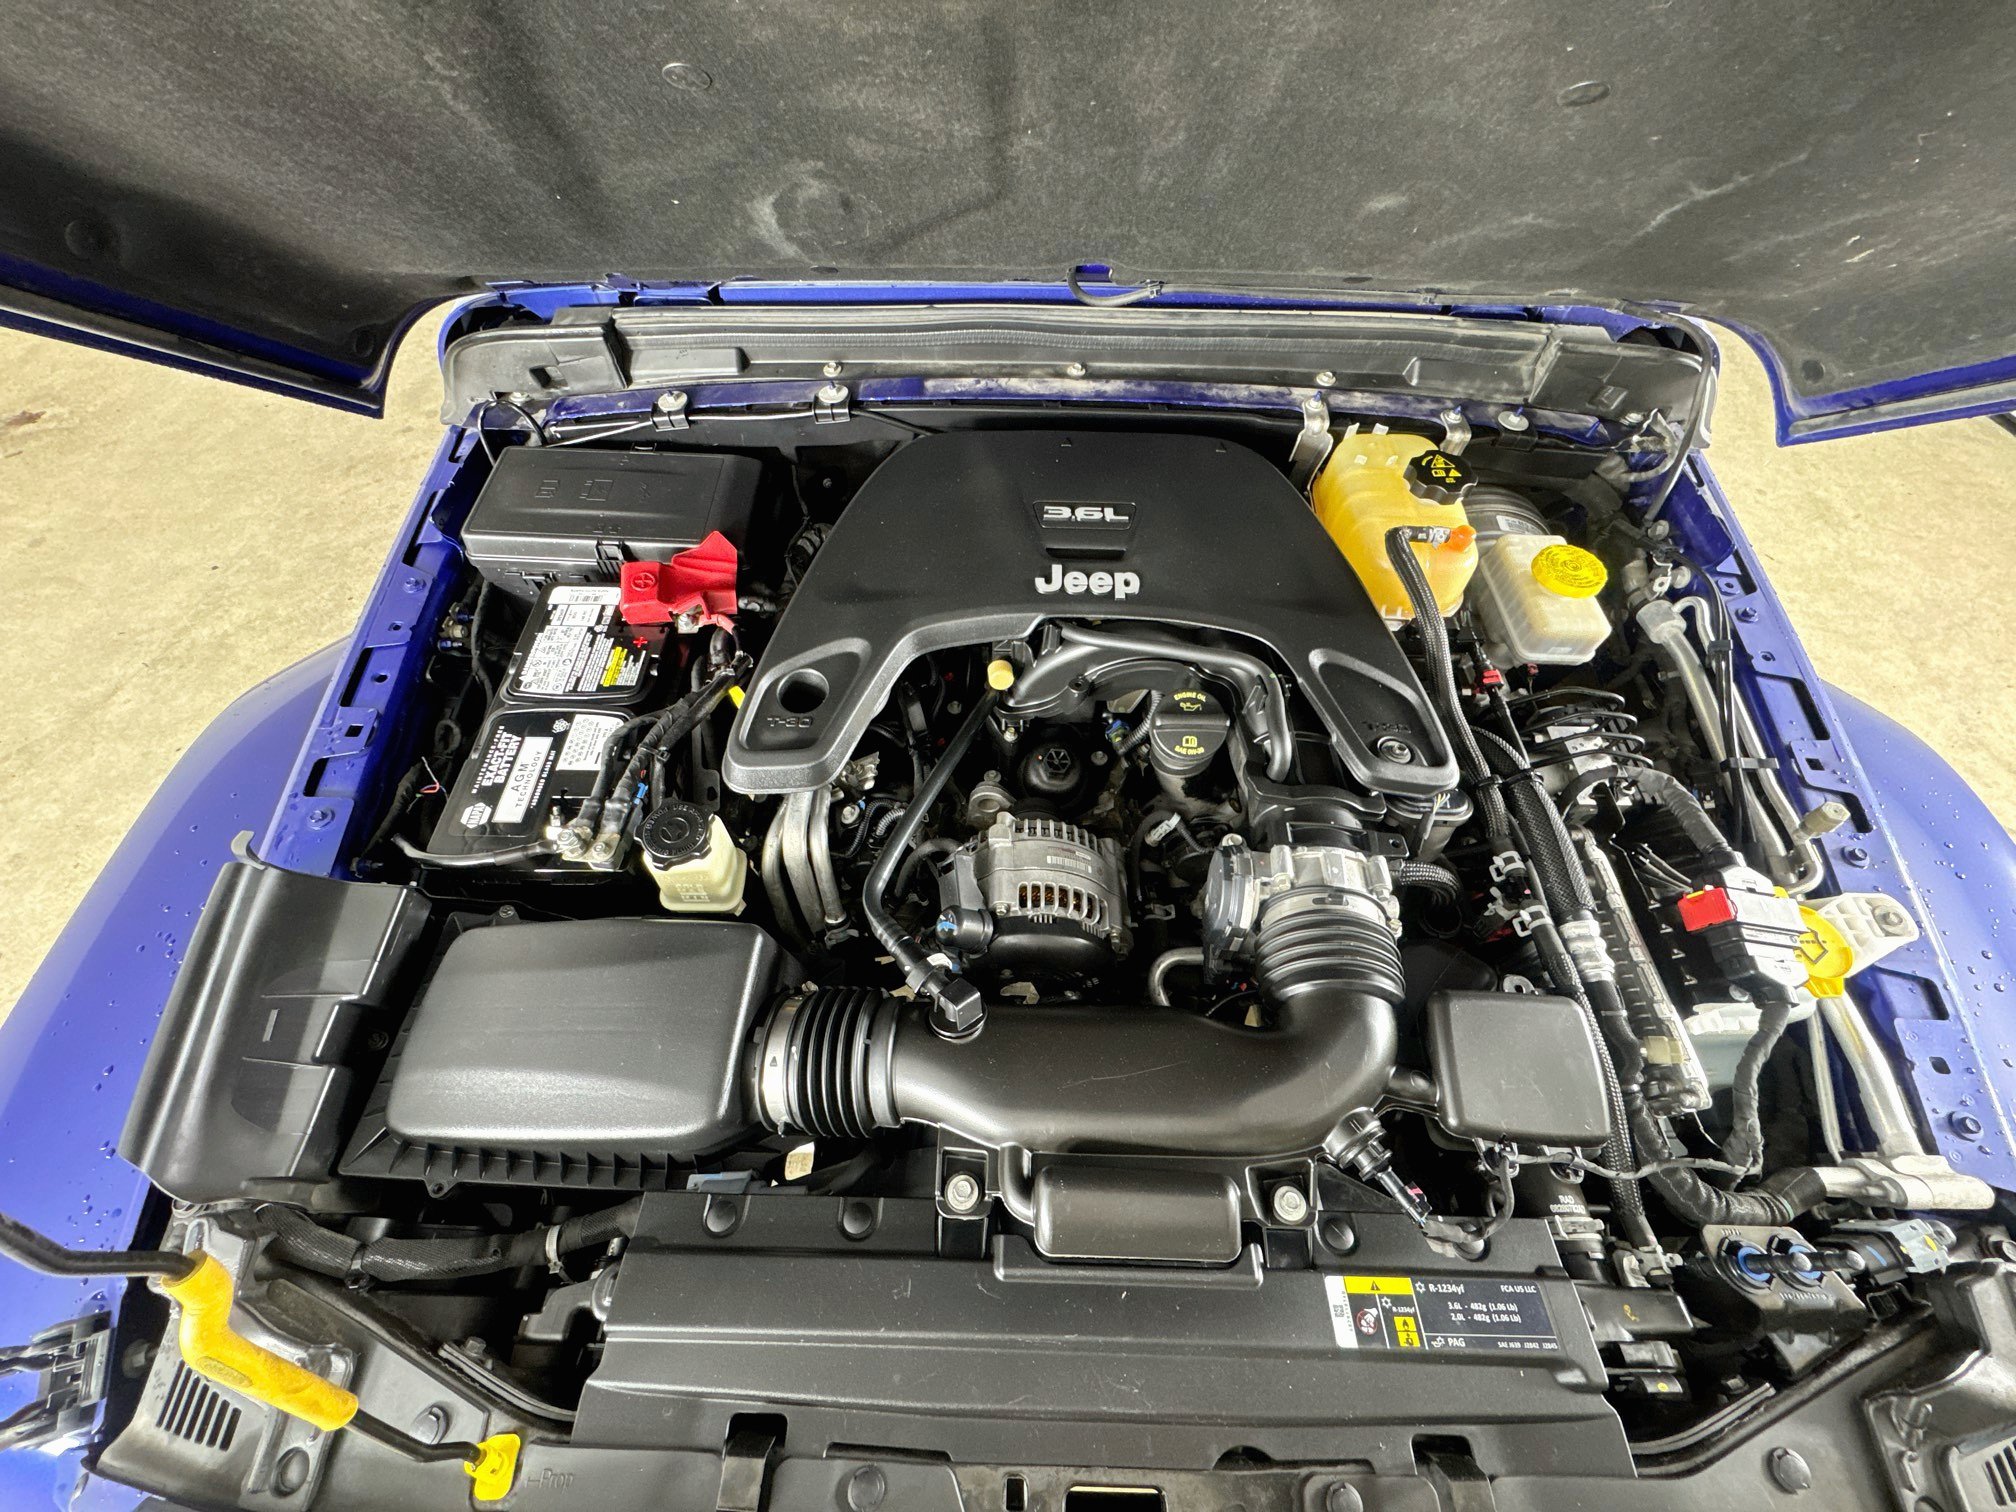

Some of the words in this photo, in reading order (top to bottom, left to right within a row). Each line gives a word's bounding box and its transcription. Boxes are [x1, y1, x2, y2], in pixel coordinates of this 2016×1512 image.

[1043, 505, 1129, 522] 3.6L
[1034, 564, 1140, 601] Jeep
[1173, 691, 1196, 700] ENGINE
[1197, 693, 1206, 702] OIL
[481, 731, 512, 787] EXACT-FIT
[494, 735, 522, 783] BATTERY
[511, 762, 530, 792] AGM
[515, 751, 542, 808] TECHNOLOGY
[1558, 1195, 1575, 1204] RAD
[1429, 1283, 1465, 1295] R-1234yf
[1500, 1284, 1514, 1293] FCA
[1515, 1285, 1524, 1293] US
[1525, 1285, 1537, 1293] LLC
[1447, 1301, 1462, 1310] 3.6L
[1470, 1302, 1487, 1312] 482g
[1507, 1303, 1518, 1312] Lb)
[1450, 1313, 1465, 1321] 2.0L
[1473, 1314, 1491, 1323] 482g
[1510, 1314, 1522, 1324] Lb)
[1447, 1338, 1466, 1347] PAG
[539, 1467, 575, 1495] Prop
